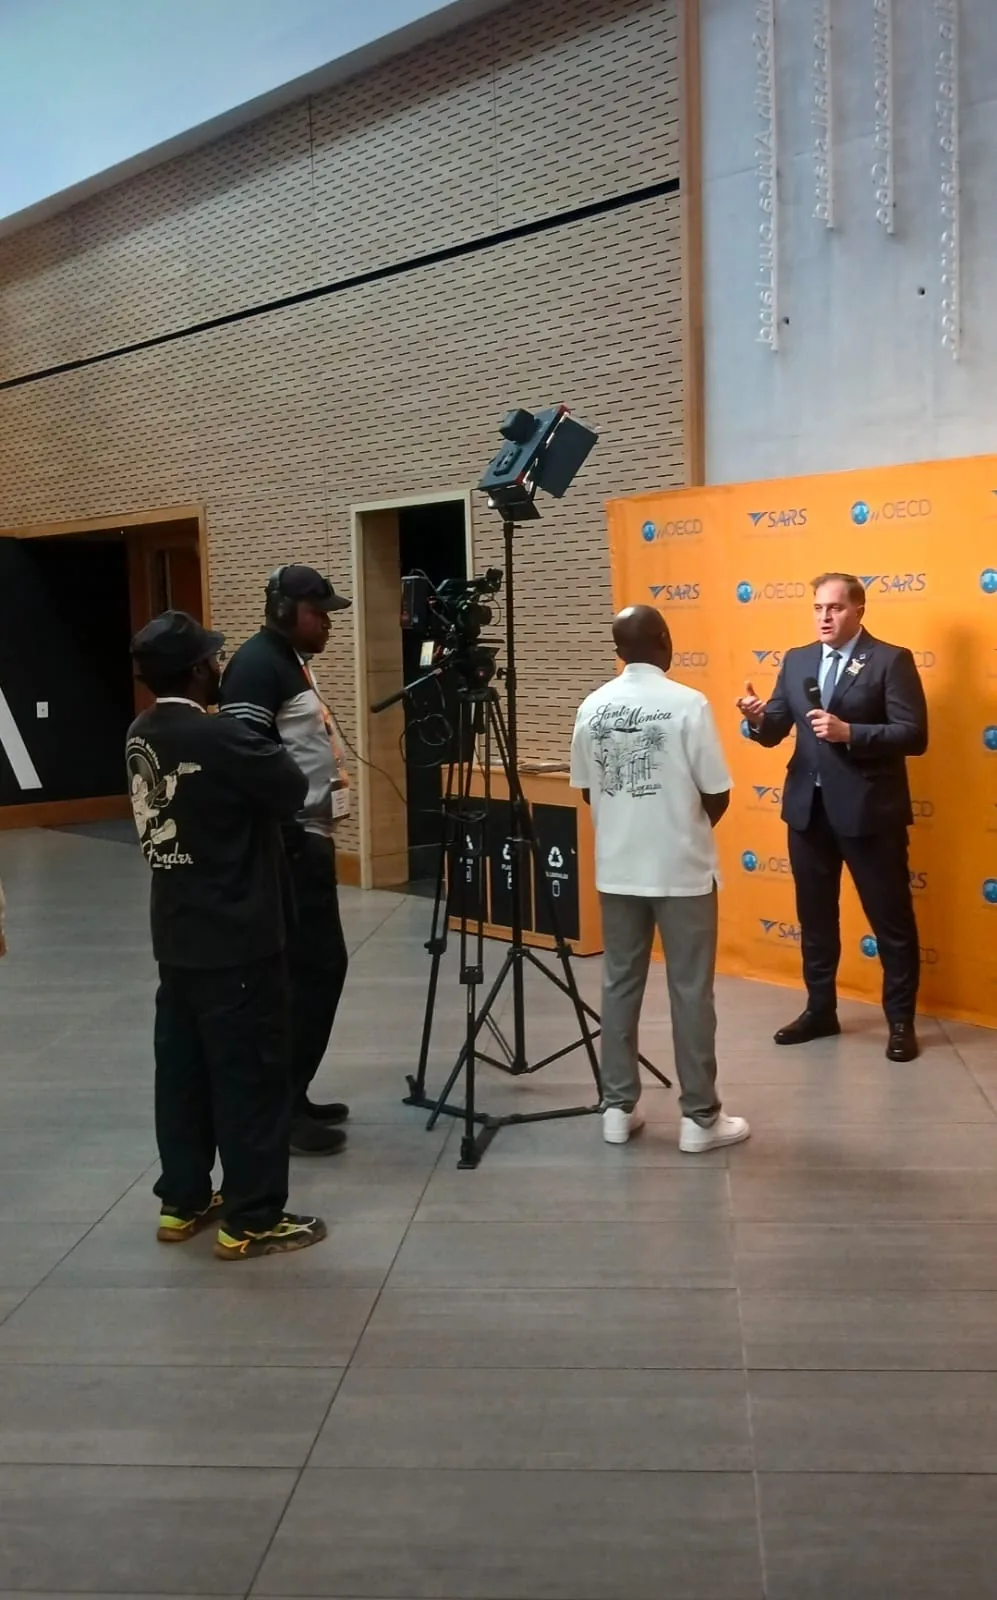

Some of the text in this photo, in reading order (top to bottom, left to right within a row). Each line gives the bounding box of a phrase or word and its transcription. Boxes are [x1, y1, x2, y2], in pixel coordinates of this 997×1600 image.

[768, 508, 808, 528] SARS
[881, 499, 932, 519] OECD
[665, 518, 703, 536] OECD
[666, 583, 700, 601] SARS
[764, 582, 806, 600] OECD
[879, 573, 926, 593] SARS
[614, 706, 673, 728] Monica
